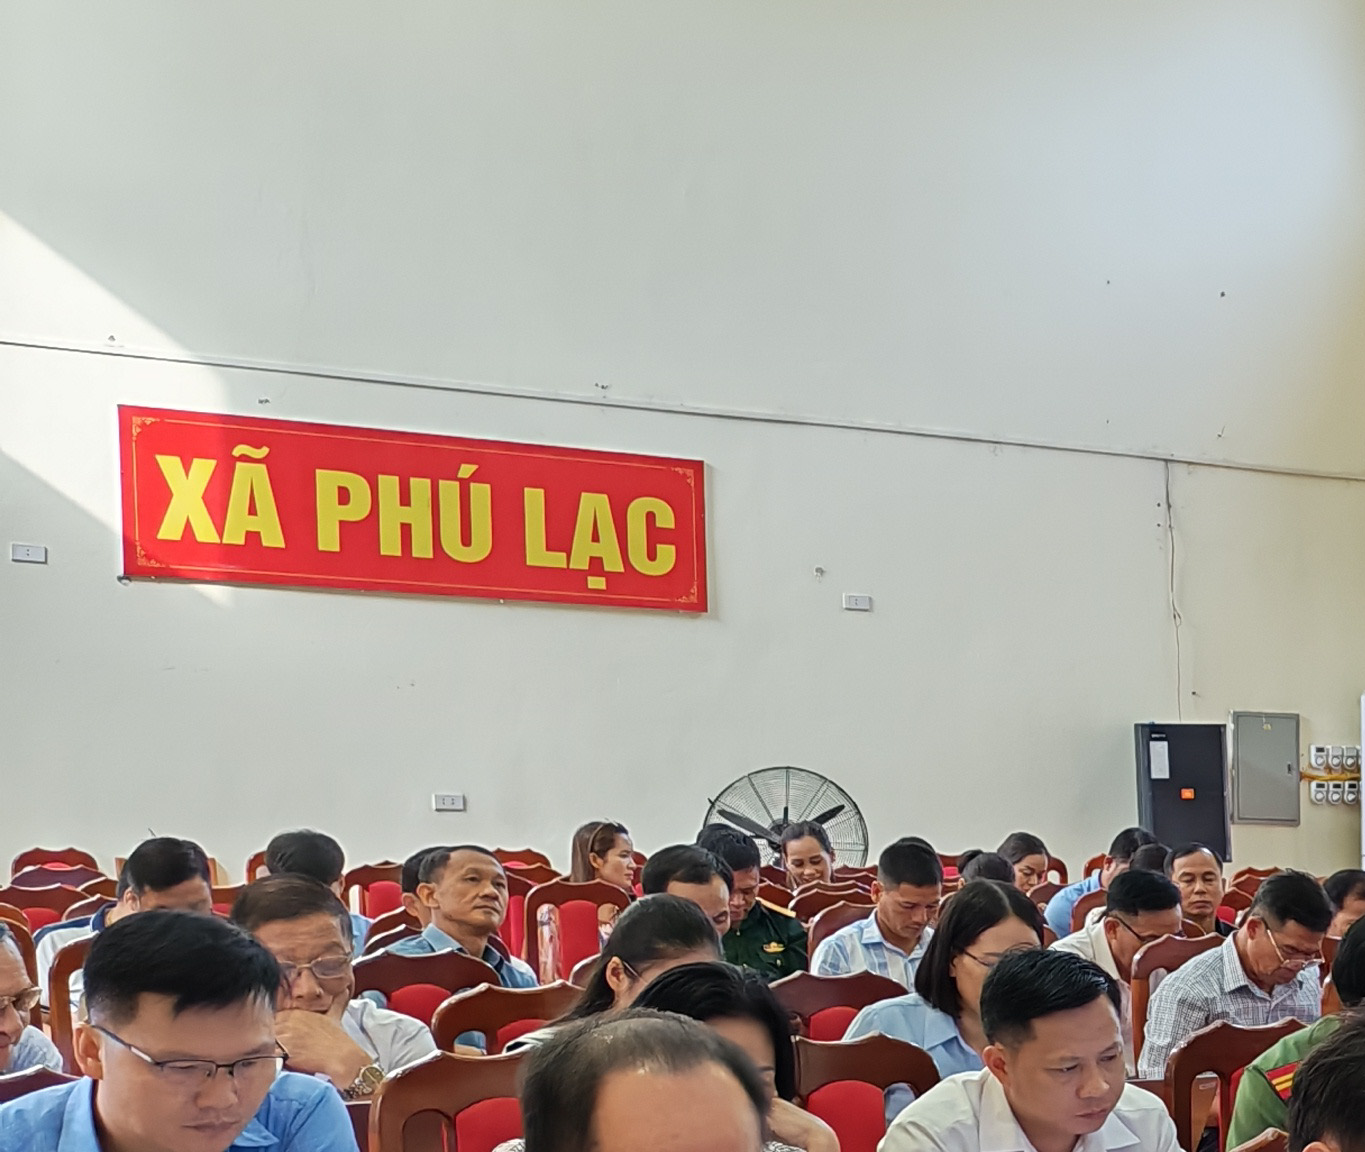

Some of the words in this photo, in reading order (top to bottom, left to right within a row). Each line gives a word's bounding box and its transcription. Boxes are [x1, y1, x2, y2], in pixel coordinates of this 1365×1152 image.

[154, 444, 286, 549] XÃ
[315, 464, 493, 564] PHÚ
[523, 487, 677, 590] LẠC
